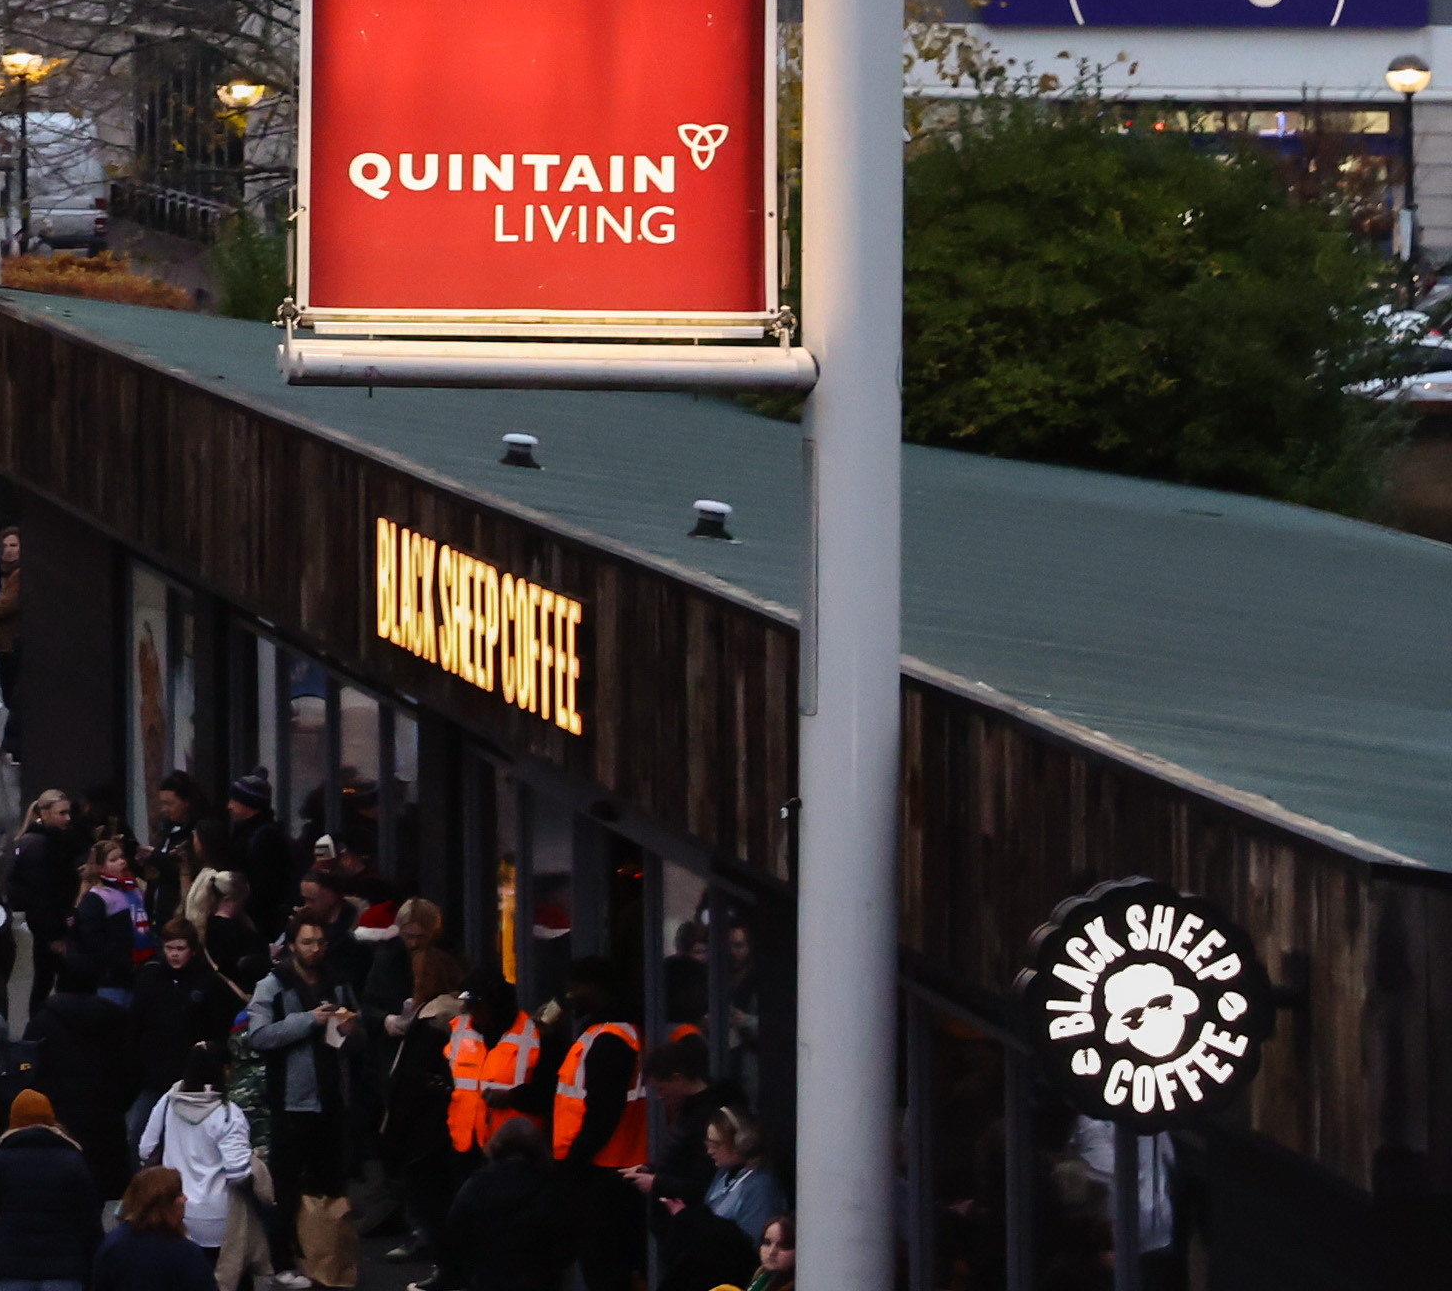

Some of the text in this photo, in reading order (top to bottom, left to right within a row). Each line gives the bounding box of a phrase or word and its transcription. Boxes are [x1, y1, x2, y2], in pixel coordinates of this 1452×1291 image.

[349, 153, 675, 200] QUINTAIN
[495, 205, 675, 244] LIVING
[377, 517, 582, 736] BLACK SHEEP COFFEE
[1046, 903, 1242, 1040] BLACK SHEEP
[1104, 1021, 1249, 1114] COFFEE
